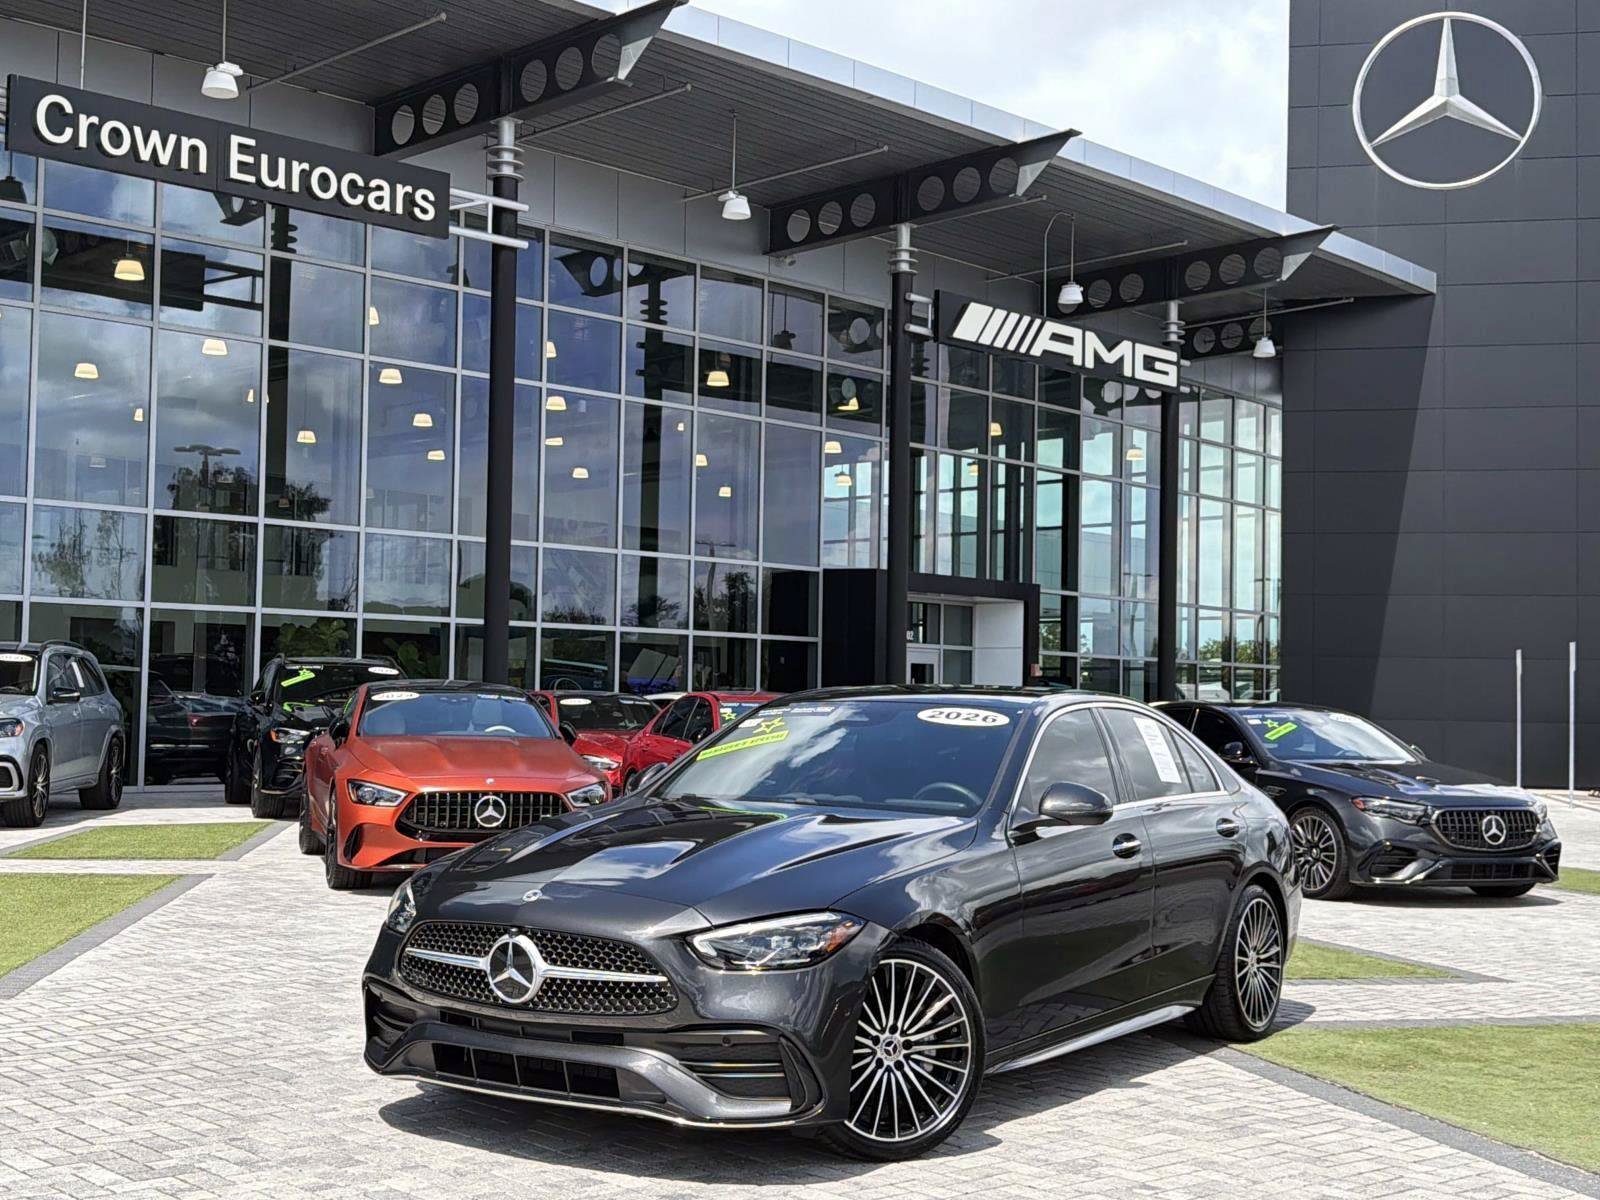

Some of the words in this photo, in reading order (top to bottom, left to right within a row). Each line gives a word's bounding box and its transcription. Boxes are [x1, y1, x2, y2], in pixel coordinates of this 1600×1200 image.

[36, 93, 208, 174] Crown
[229, 134, 436, 221] Eurocars
[1030, 320, 1178, 387] AMG
[927, 710, 998, 724] 2026
